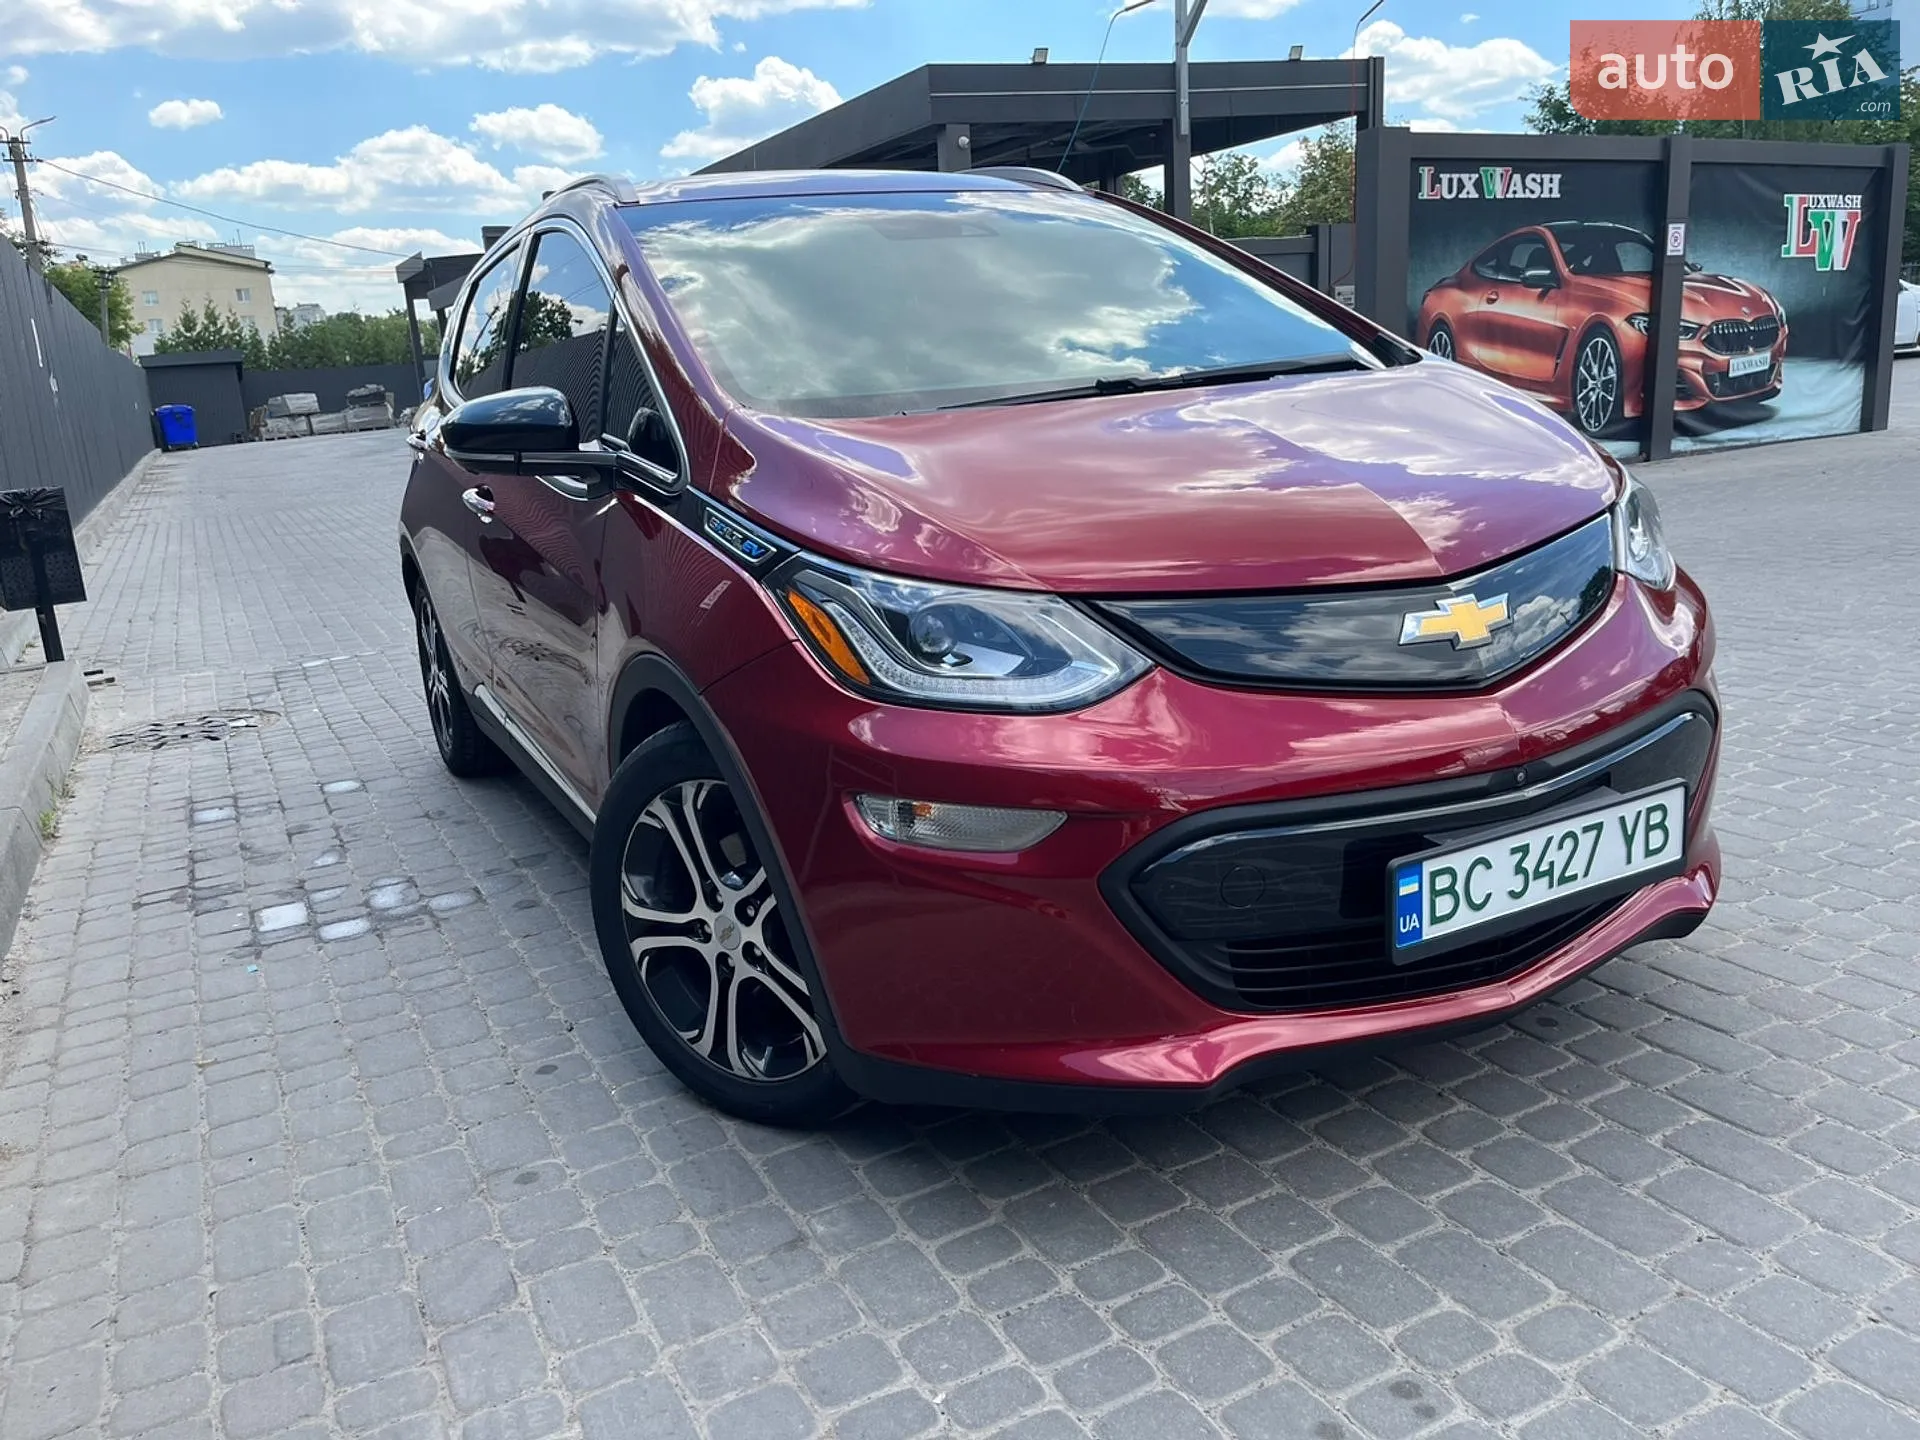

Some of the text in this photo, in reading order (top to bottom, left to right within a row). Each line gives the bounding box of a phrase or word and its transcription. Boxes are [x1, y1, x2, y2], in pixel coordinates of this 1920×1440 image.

[1429, 803, 1670, 926] BC 3427 YB
[1400, 914, 1420, 933] UA
